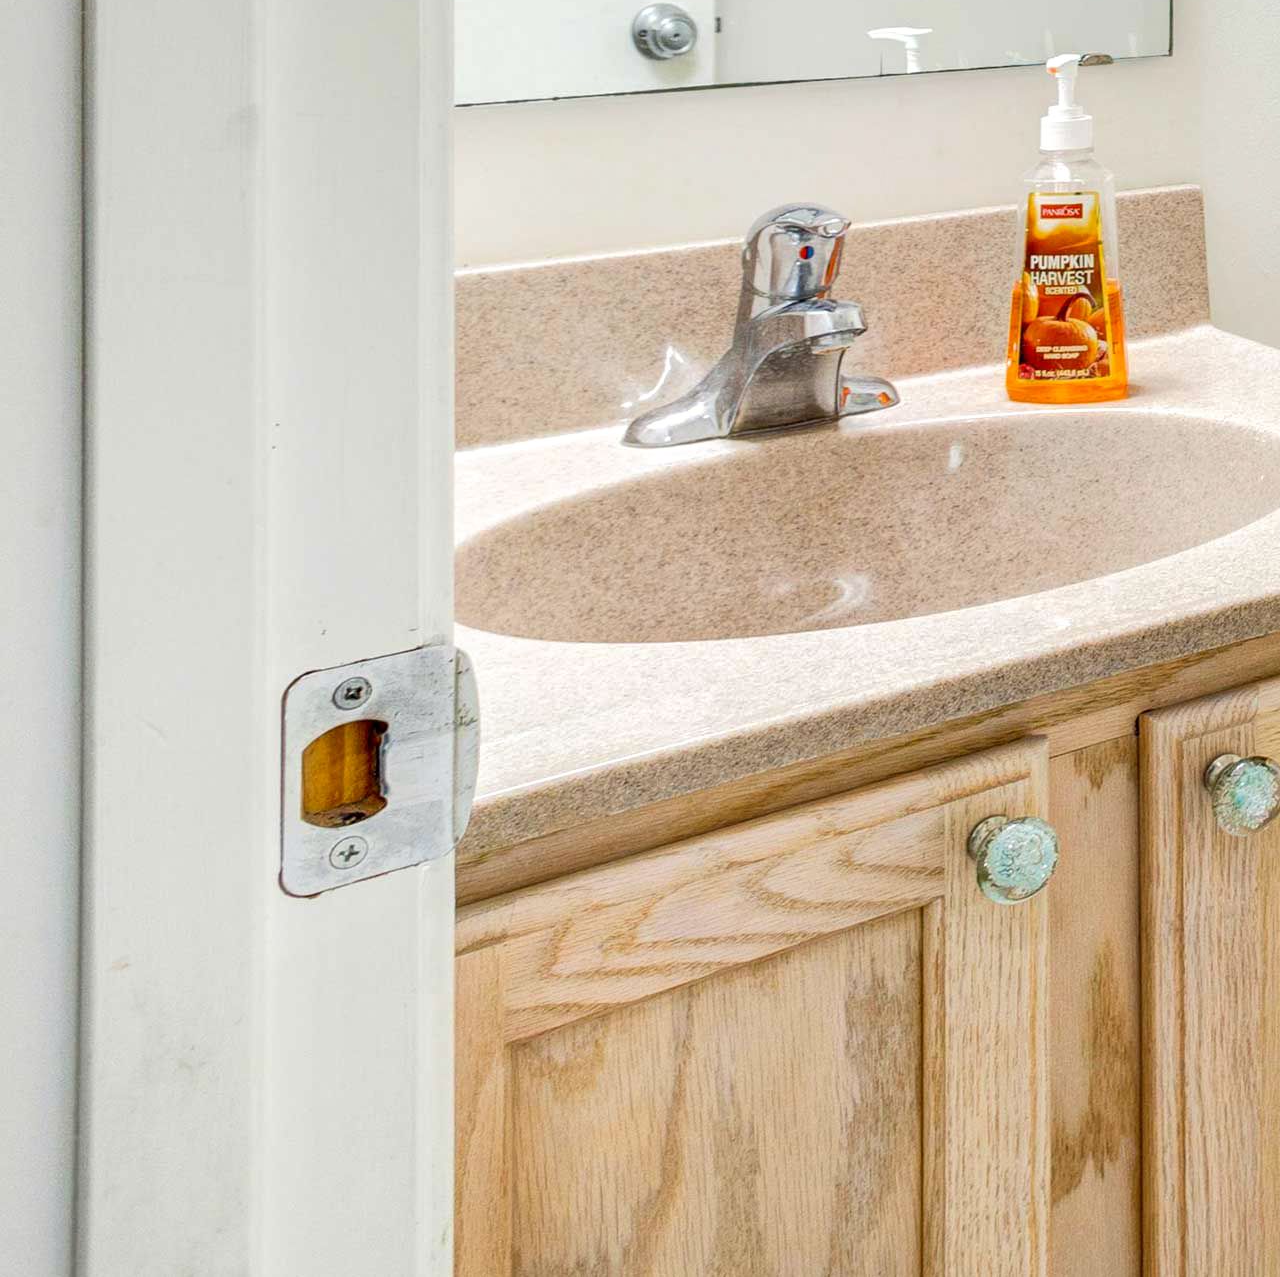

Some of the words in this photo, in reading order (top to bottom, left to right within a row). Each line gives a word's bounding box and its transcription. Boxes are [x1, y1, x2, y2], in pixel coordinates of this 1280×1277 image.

[1030, 254, 1095, 270] PUMPKIN
[1030, 270, 1095, 286] HARVEST
[1044, 286, 1077, 295] SCENTED
